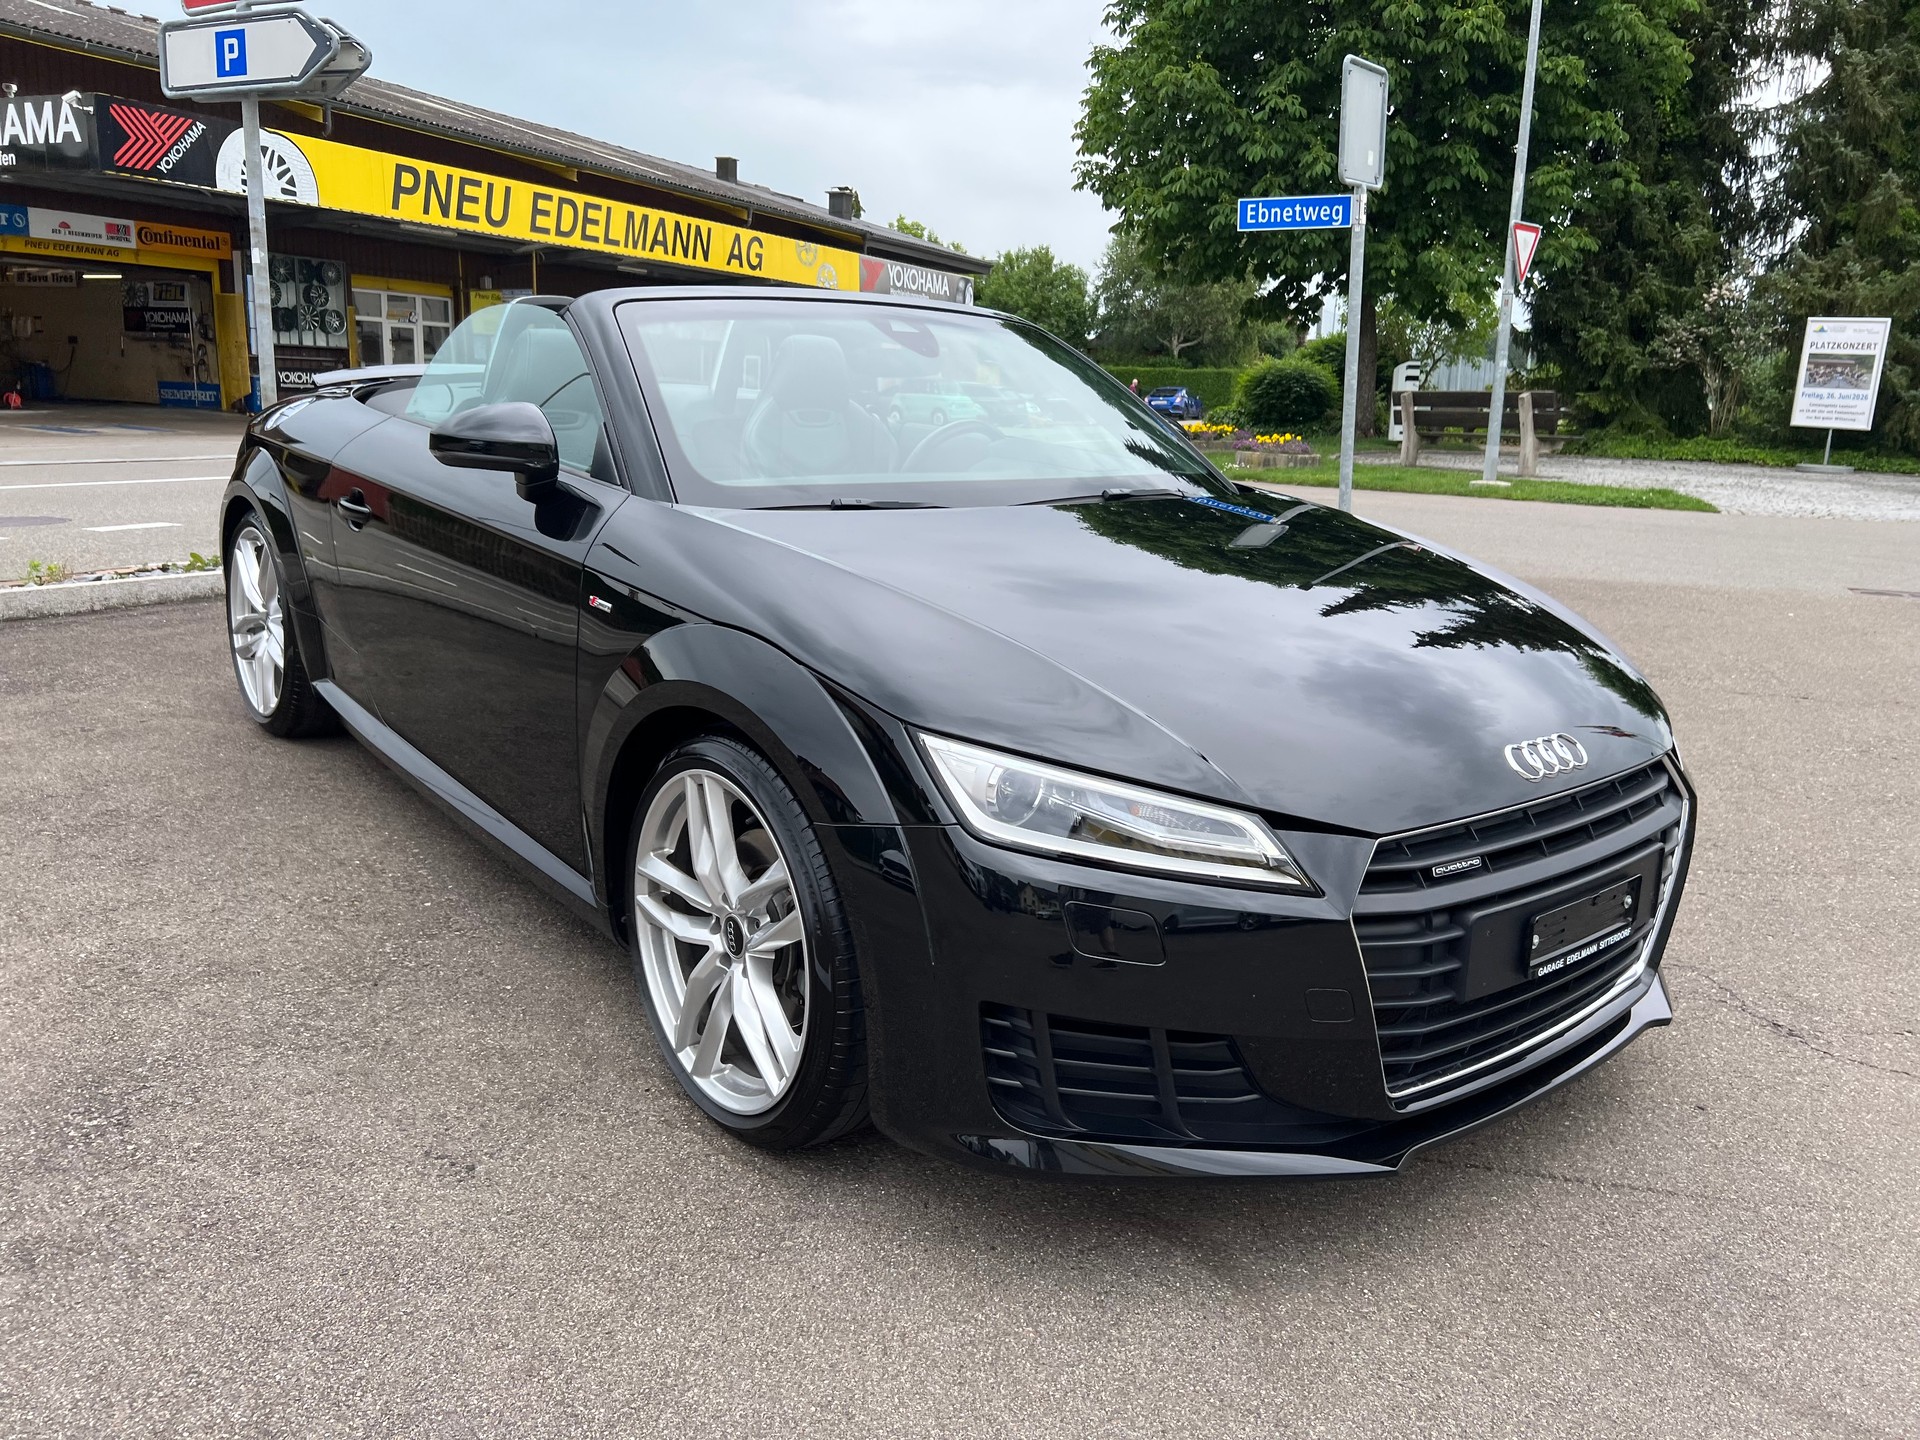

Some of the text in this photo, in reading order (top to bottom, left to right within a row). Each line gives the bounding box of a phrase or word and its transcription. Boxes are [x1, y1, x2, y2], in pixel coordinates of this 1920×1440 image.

[224, 37, 239, 71] P
[0, 101, 82, 146] AMA
[156, 121, 207, 175] YOKOHAMA
[391, 163, 764, 271] PNEU EDELMANN AG
[1247, 203, 1343, 226] Ebnetweg
[25, 240, 120, 257] PNEU EDELMANN AG
[137, 226, 221, 250] Continental
[888, 263, 950, 297] YOKOHAMA
[144, 310, 191, 324] YOKOHAMA
[1810, 341, 1879, 351] PLATZKONZERT
[278, 371, 316, 384] YOKOHA
[160, 388, 217, 402] SEMPERIT
[1435, 857, 1480, 875] quattro
[1537, 927, 1632, 977] GARAGE EDELMANN SITTERDORF
